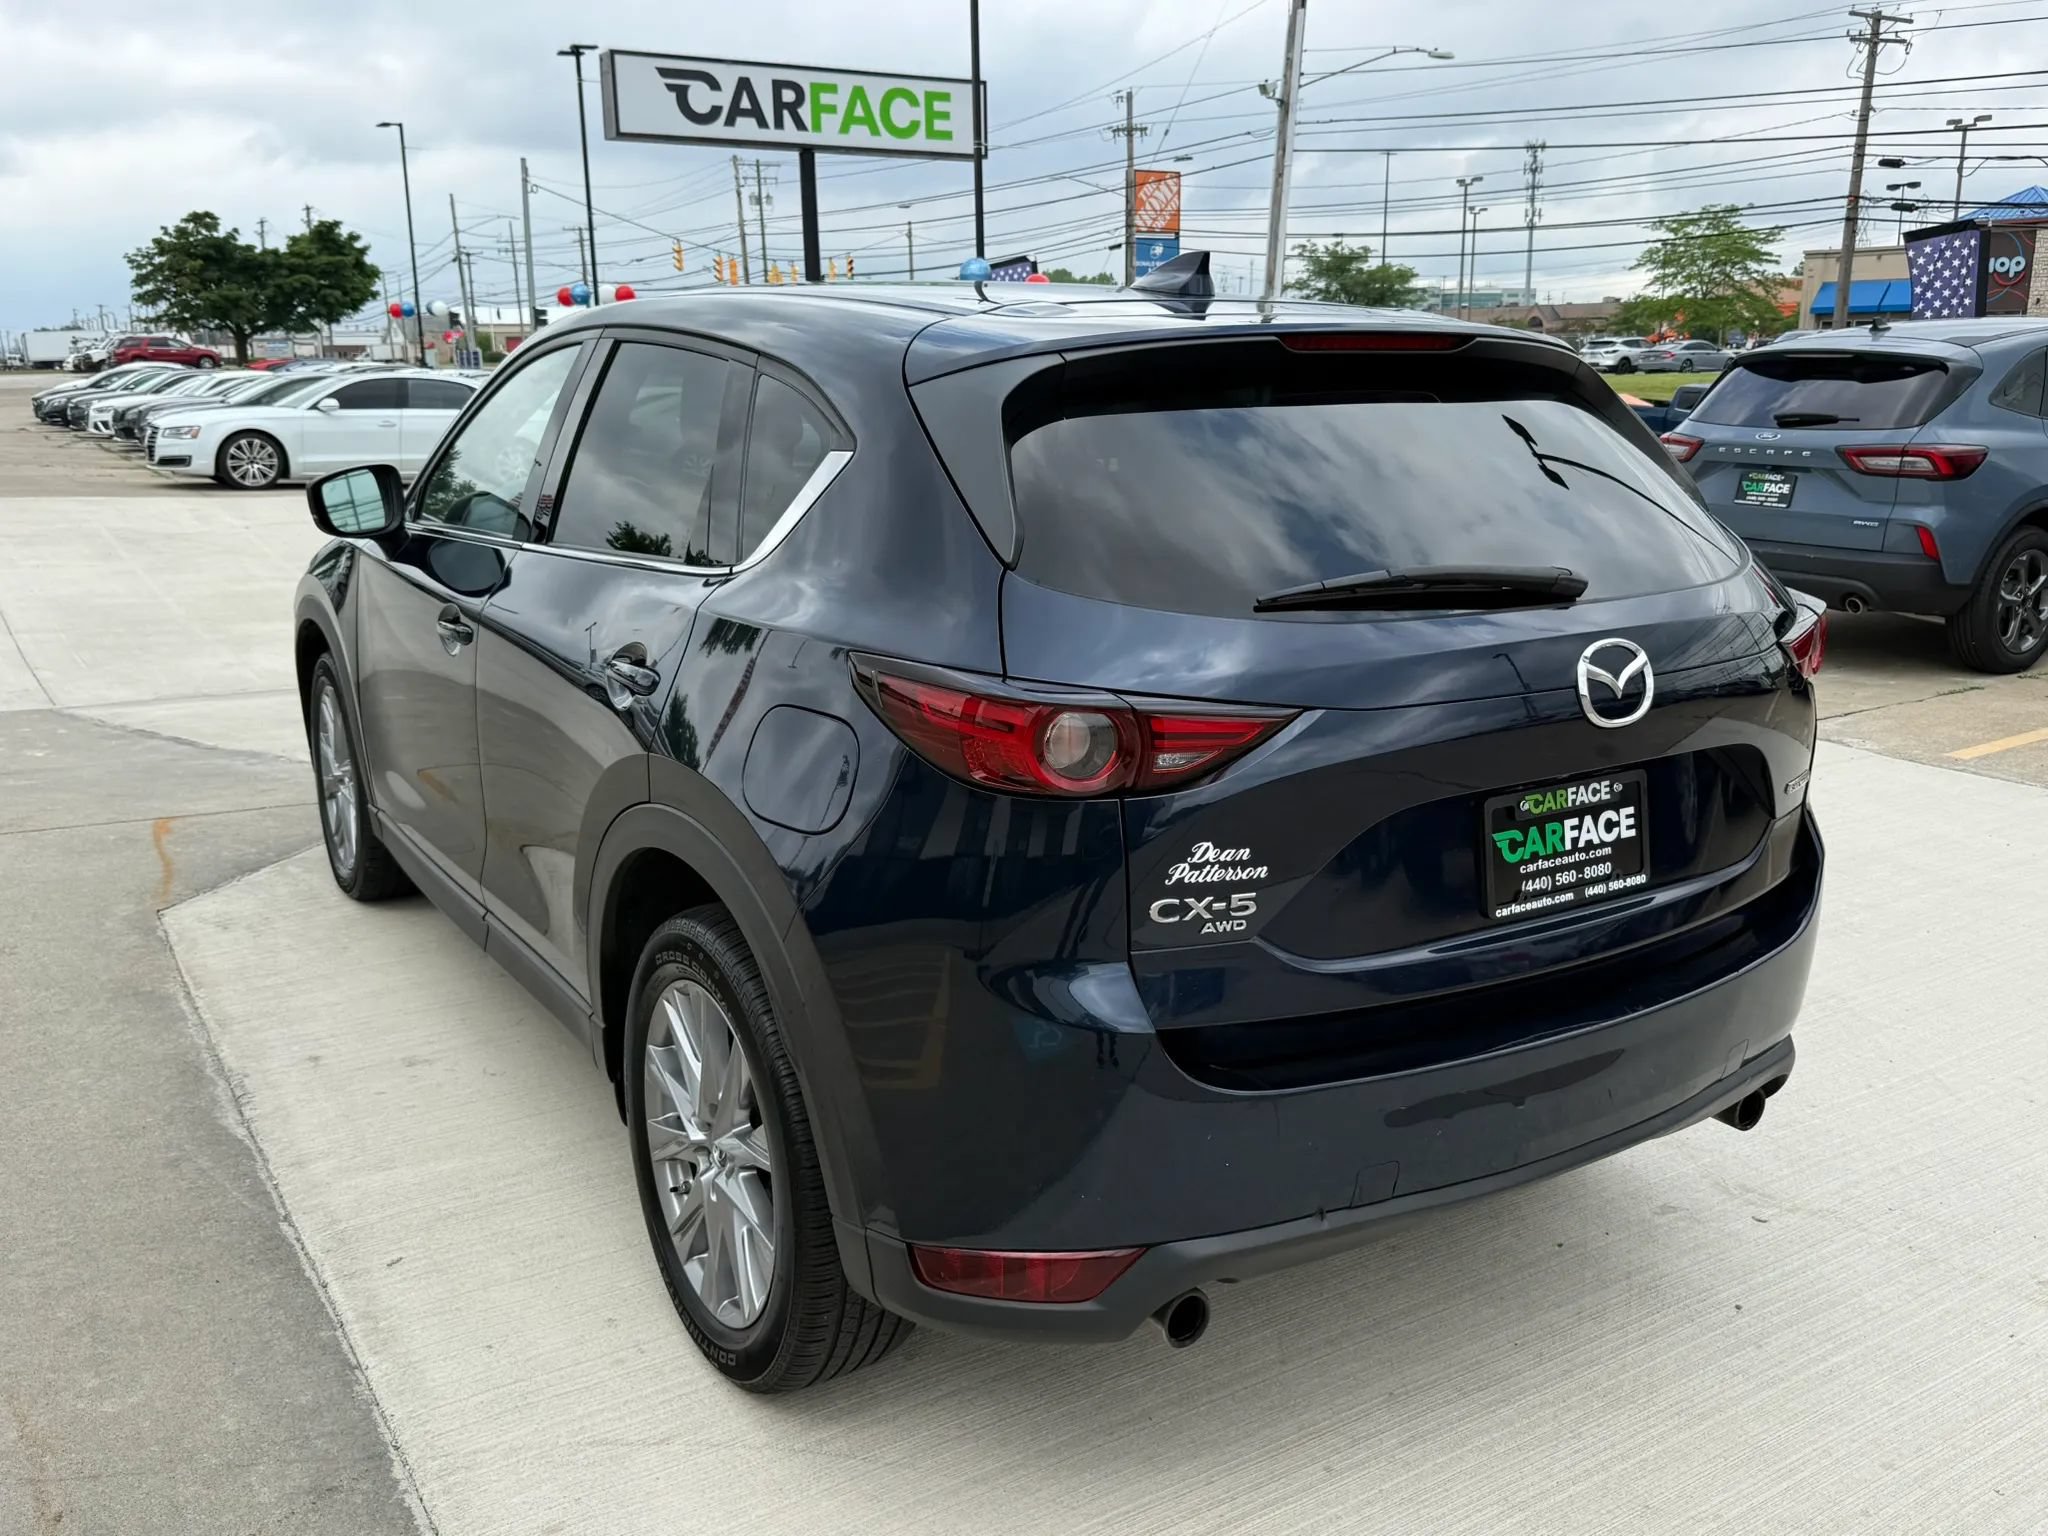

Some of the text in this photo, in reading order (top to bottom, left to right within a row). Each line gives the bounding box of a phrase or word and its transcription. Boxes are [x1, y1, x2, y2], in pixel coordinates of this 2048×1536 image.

[655, 66, 954, 142] CARFACE
[1741, 480, 1791, 494] CARFACE
[1524, 780, 1611, 815] CARFACE
[1492, 806, 1637, 864] CARFACE
[1187, 841, 1252, 864] Dean
[1519, 846, 1612, 874] carfaceauto.com
[1164, 862, 1269, 886] Patterson
[1521, 875, 1552, 893] (440)
[1148, 892, 1258, 924] CX-5
[1495, 873, 1647, 918] carfaceauto.com (440) 560-8080
[1200, 919, 1248, 935] AWD
